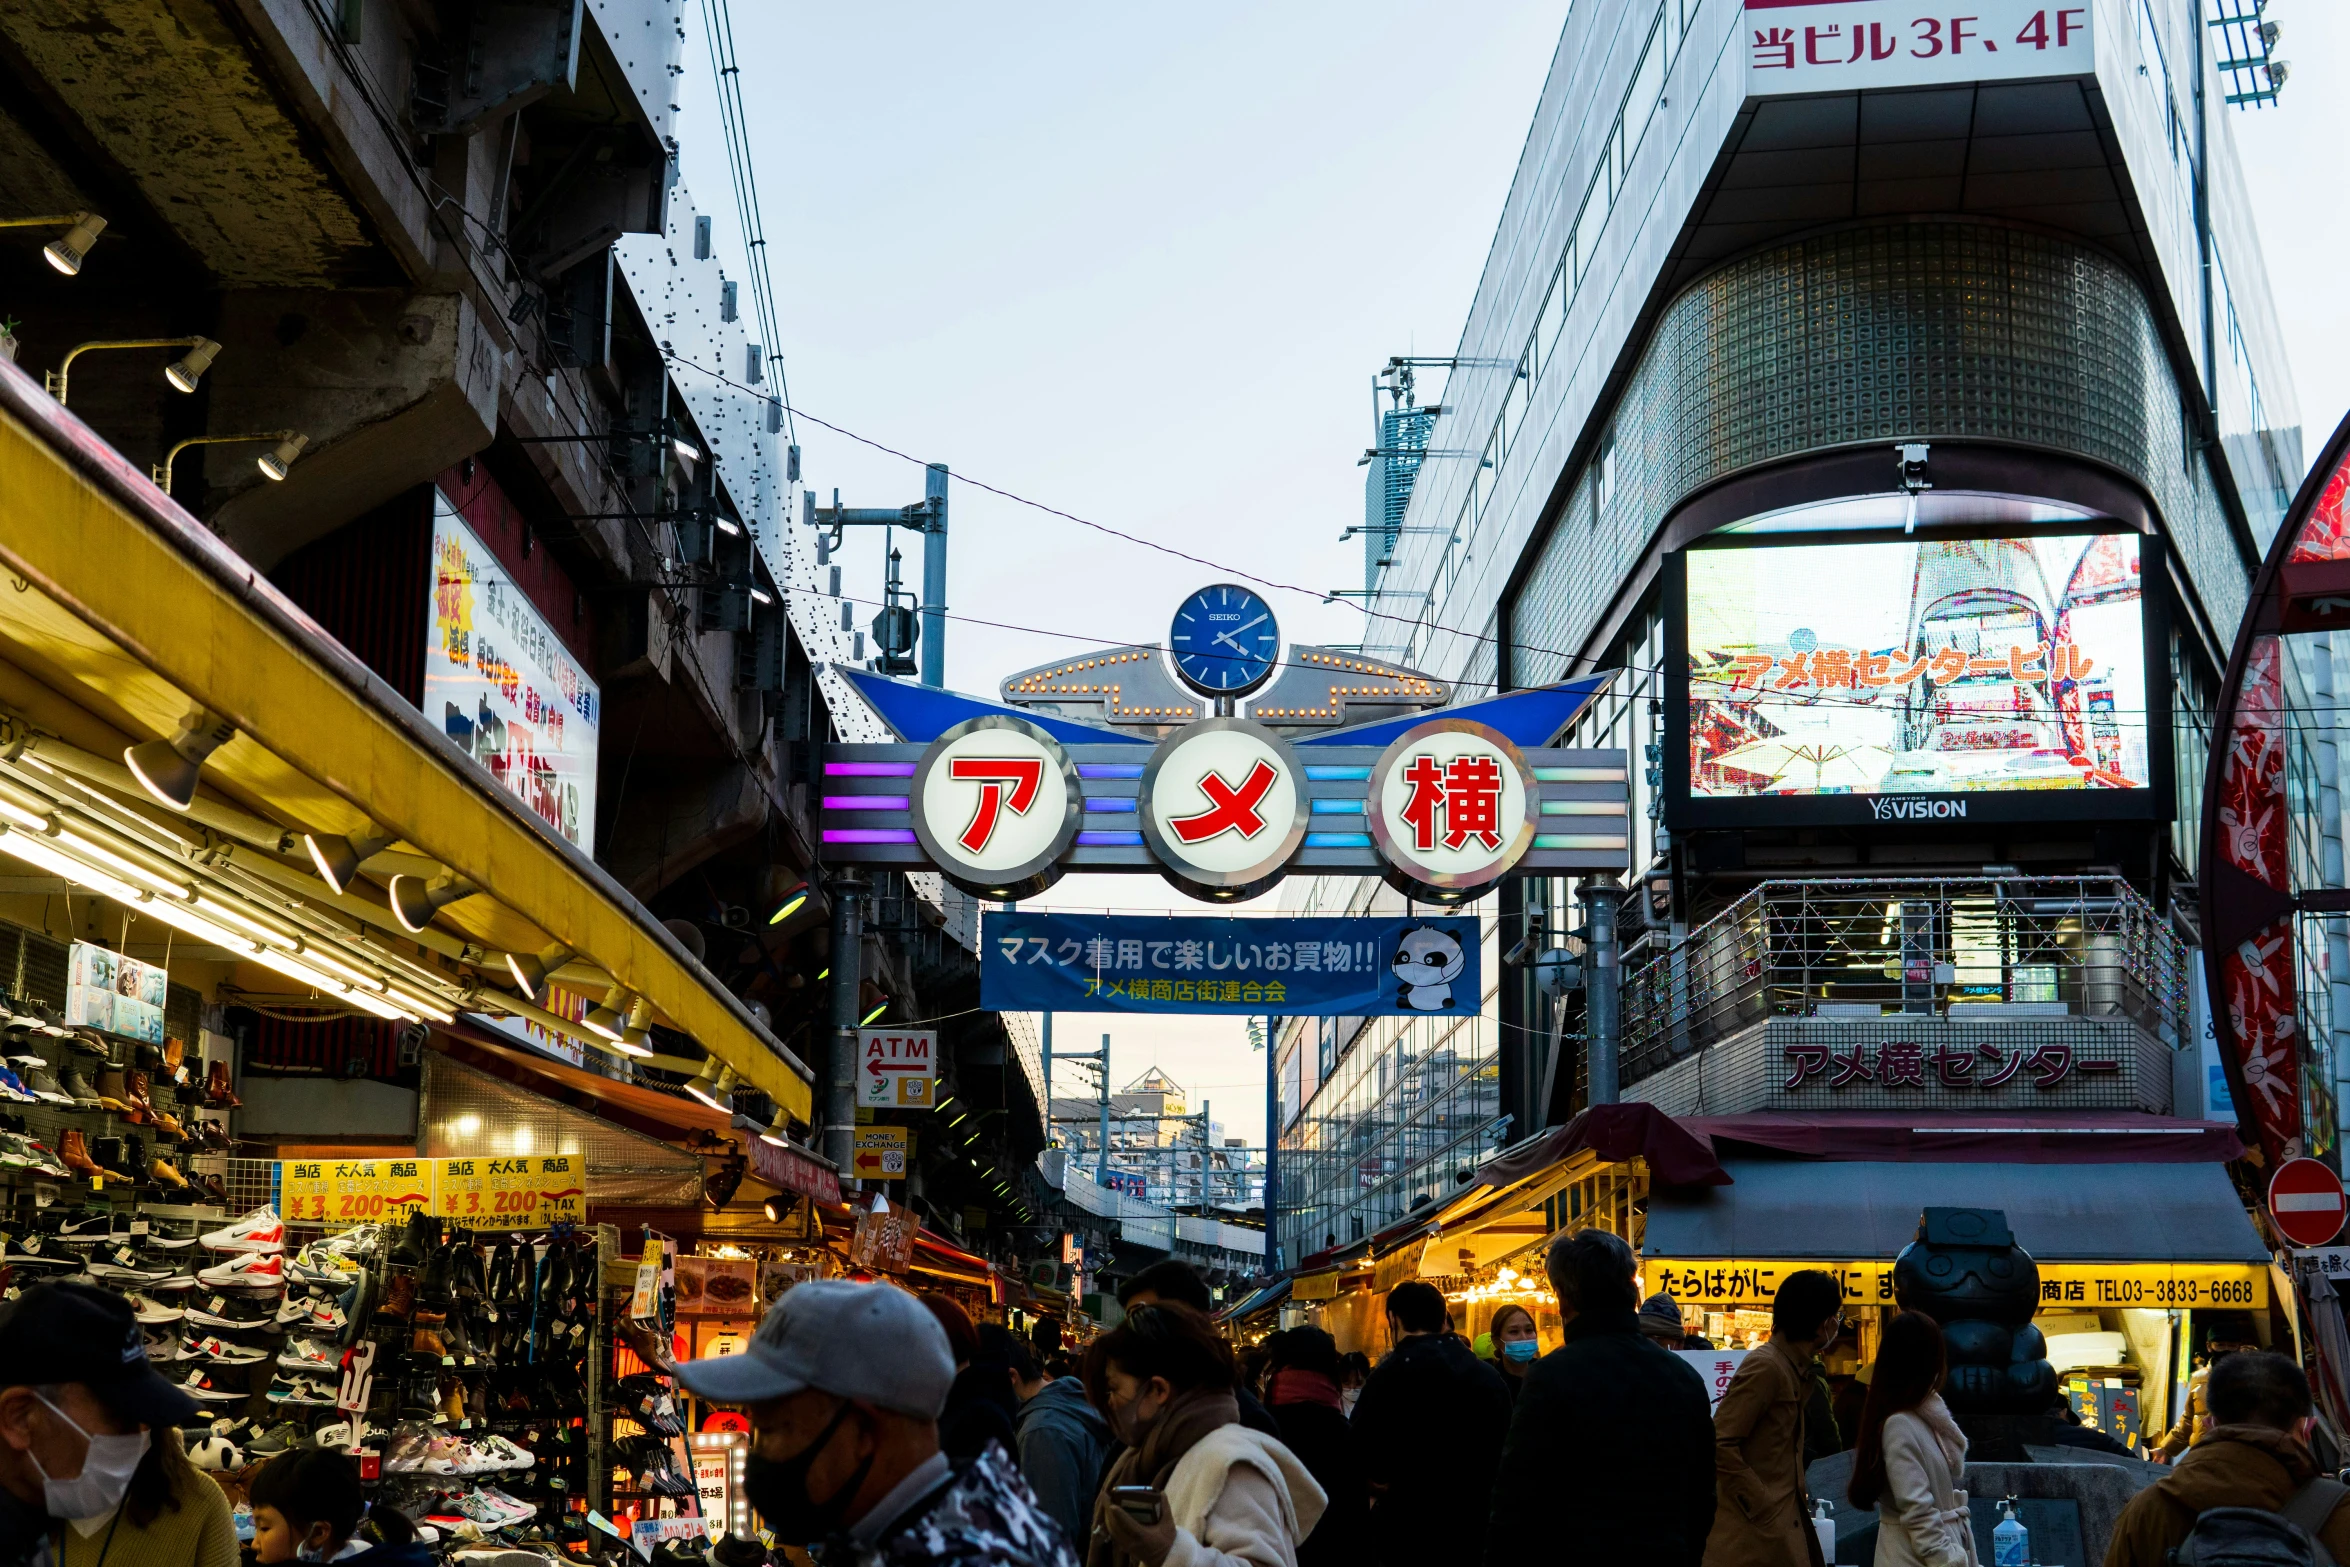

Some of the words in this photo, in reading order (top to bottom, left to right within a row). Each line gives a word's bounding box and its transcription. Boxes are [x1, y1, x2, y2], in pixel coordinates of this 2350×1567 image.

[1752, 22, 1896, 69] 当ビル
[438, 567, 461, 624] 激安
[1208, 613, 1241, 622] SEIKO
[449, 623, 469, 670] 酒場
[1735, 641, 2093, 689] アメ横センタービル
[950, 755, 1503, 853] アメ横
[997, 937, 1375, 972] マスク着用で楽しいお買物!!
[1084, 978, 1287, 1002] アメ横商店街連合会
[867, 1038, 928, 1058] ATM
[1784, 1042, 2119, 1089] アメ横センター
[293, 1162, 321, 1178] 当店
[335, 1162, 376, 1177] 大人気
[390, 1161, 418, 1177] 商品
[442, 1179, 483, 1192] コスパ重視
[491, 1175, 576, 1189] 定番ビジネスシューズ
[448, 1161, 474, 1176] 当店
[488, 1160, 528, 1174] 大人気
[542, 1158, 569, 1173] 商品
[288, 1181, 330, 1194] コスパ重視
[337, 1180, 425, 1193] 定番ビジネスシューズ
[1660, 1267, 1776, 1298] たらばがに
[2095, 1279, 2253, 1302] TEL03-3833-6668
